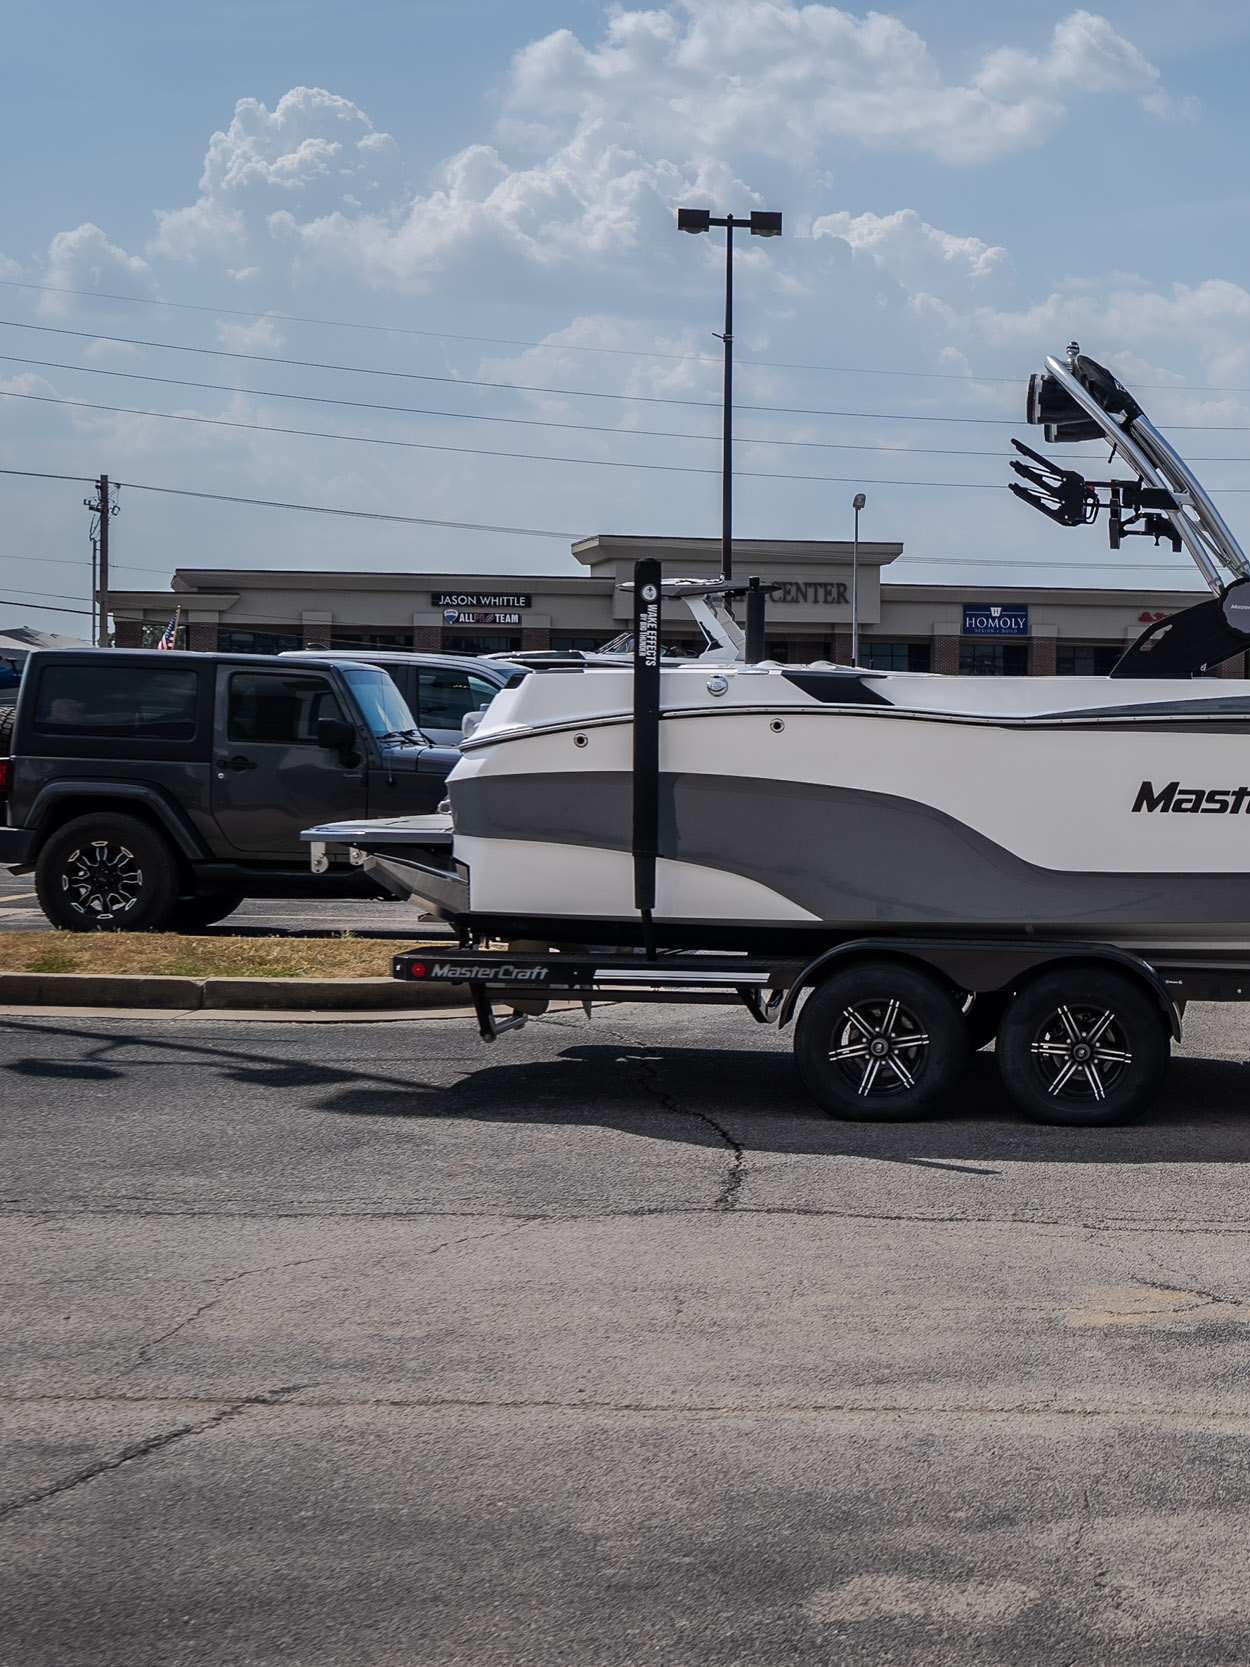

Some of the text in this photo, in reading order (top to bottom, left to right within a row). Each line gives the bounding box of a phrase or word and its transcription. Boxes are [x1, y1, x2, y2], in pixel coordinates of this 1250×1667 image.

[769, 581, 850, 604] CENTER
[439, 595, 526, 606] JASON WHITTLE
[495, 614, 519, 623] TEAM
[966, 617, 1026, 628] HOMOLY
[645, 604, 658, 666] WAKE EFFECTS
[431, 963, 549, 980] MasterCraft
